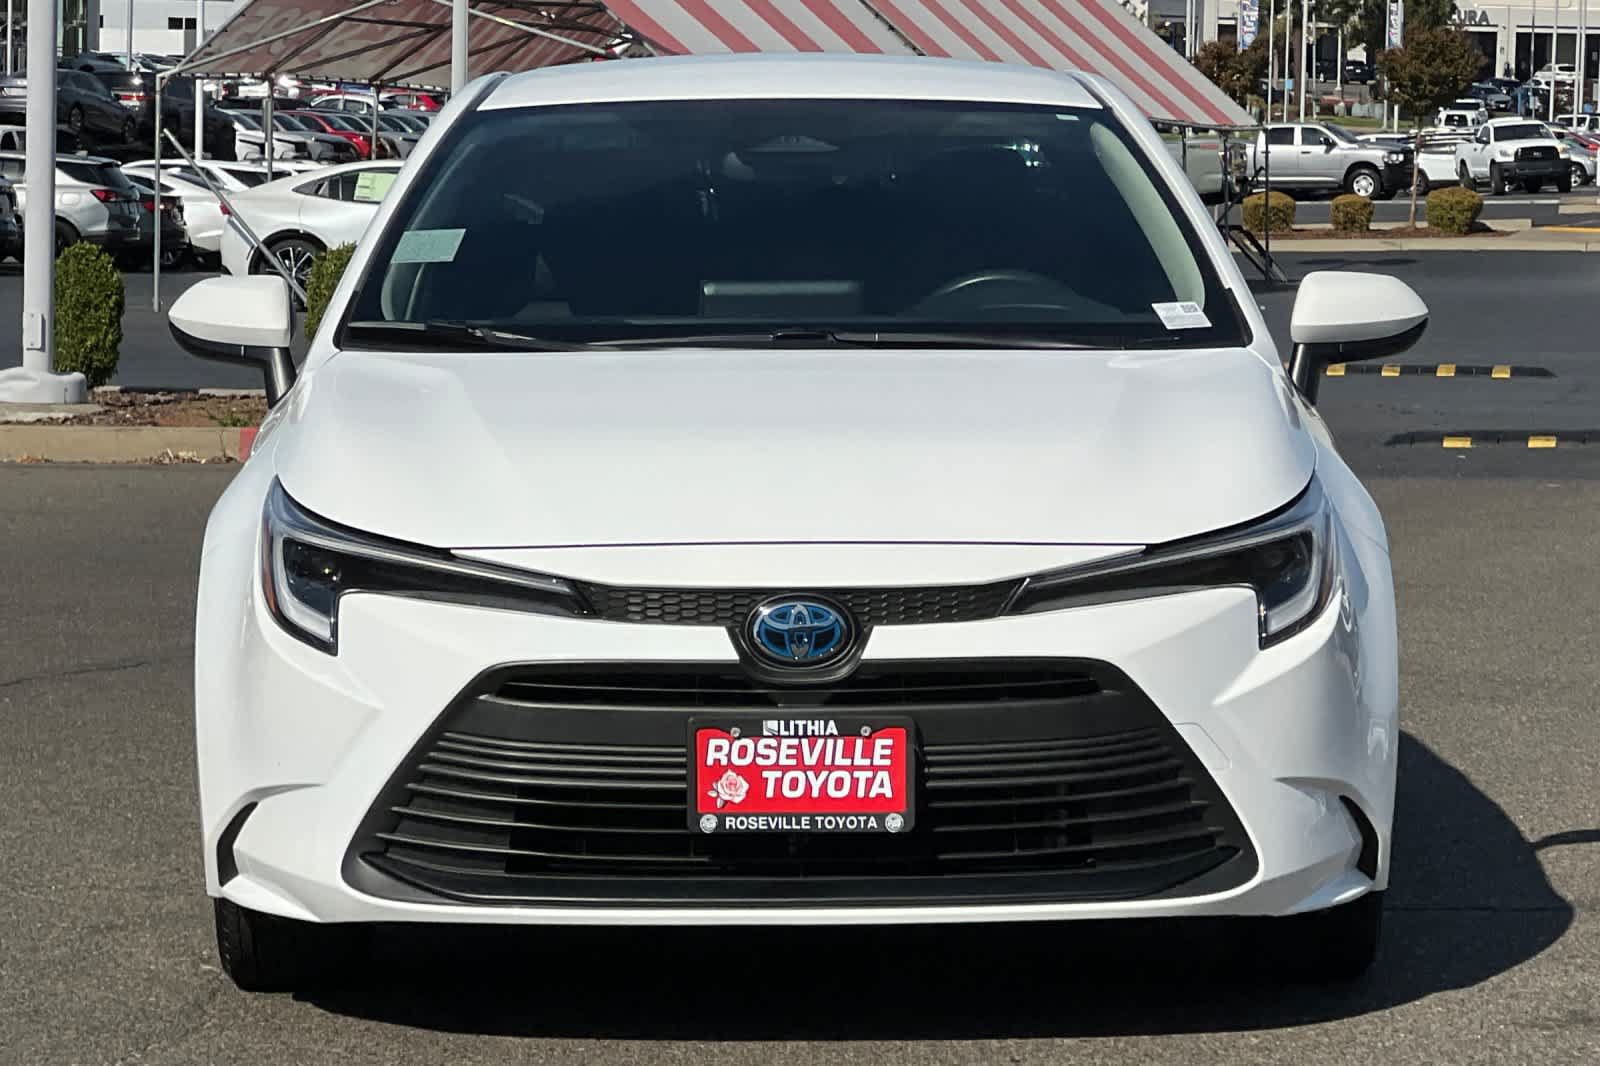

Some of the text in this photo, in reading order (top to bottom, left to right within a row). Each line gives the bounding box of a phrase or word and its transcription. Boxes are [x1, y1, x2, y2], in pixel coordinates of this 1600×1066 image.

[780, 720, 838, 736] LITHIA
[706, 738, 893, 766] ROSEVILLE
[762, 770, 893, 798] TOYOTA
[725, 816, 878, 830] ROSEVILLE TOYOTA
